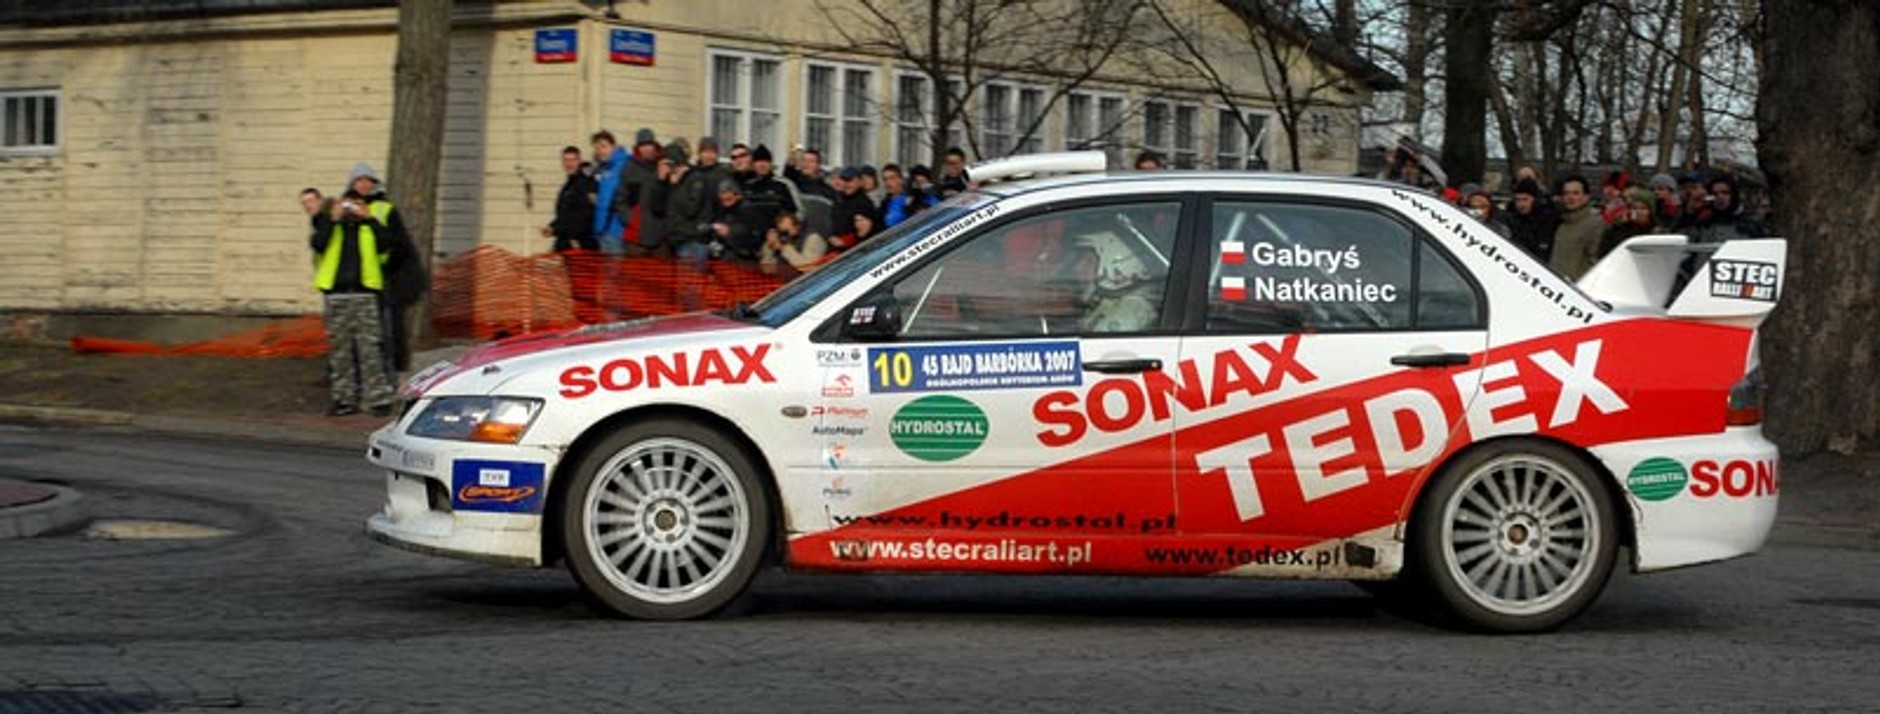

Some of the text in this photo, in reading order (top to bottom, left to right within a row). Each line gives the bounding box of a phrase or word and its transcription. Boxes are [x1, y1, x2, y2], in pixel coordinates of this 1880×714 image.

[1253, 242, 1360, 273] Gabryś
[1391, 189, 1595, 324] www.hydrostal.pl
[1715, 262, 1776, 285] STEC
[1254, 277, 1396, 302] Natkaniec
[559, 343, 778, 399] SONAX
[874, 352, 913, 387] 10
[922, 347, 1076, 375] 45 RAJD BARBÓRKA 2007
[1032, 333, 1317, 447] SONAX
[890, 420, 985, 435] HYDROSTAL
[1195, 339, 1628, 523] TEDEX
[1690, 459, 1779, 498] SON
[833, 510, 1176, 532] www.hydrostal.pl
[830, 538, 1093, 565] www.stecraliart.pl
[1146, 545, 1341, 570] www.tedex.pl
